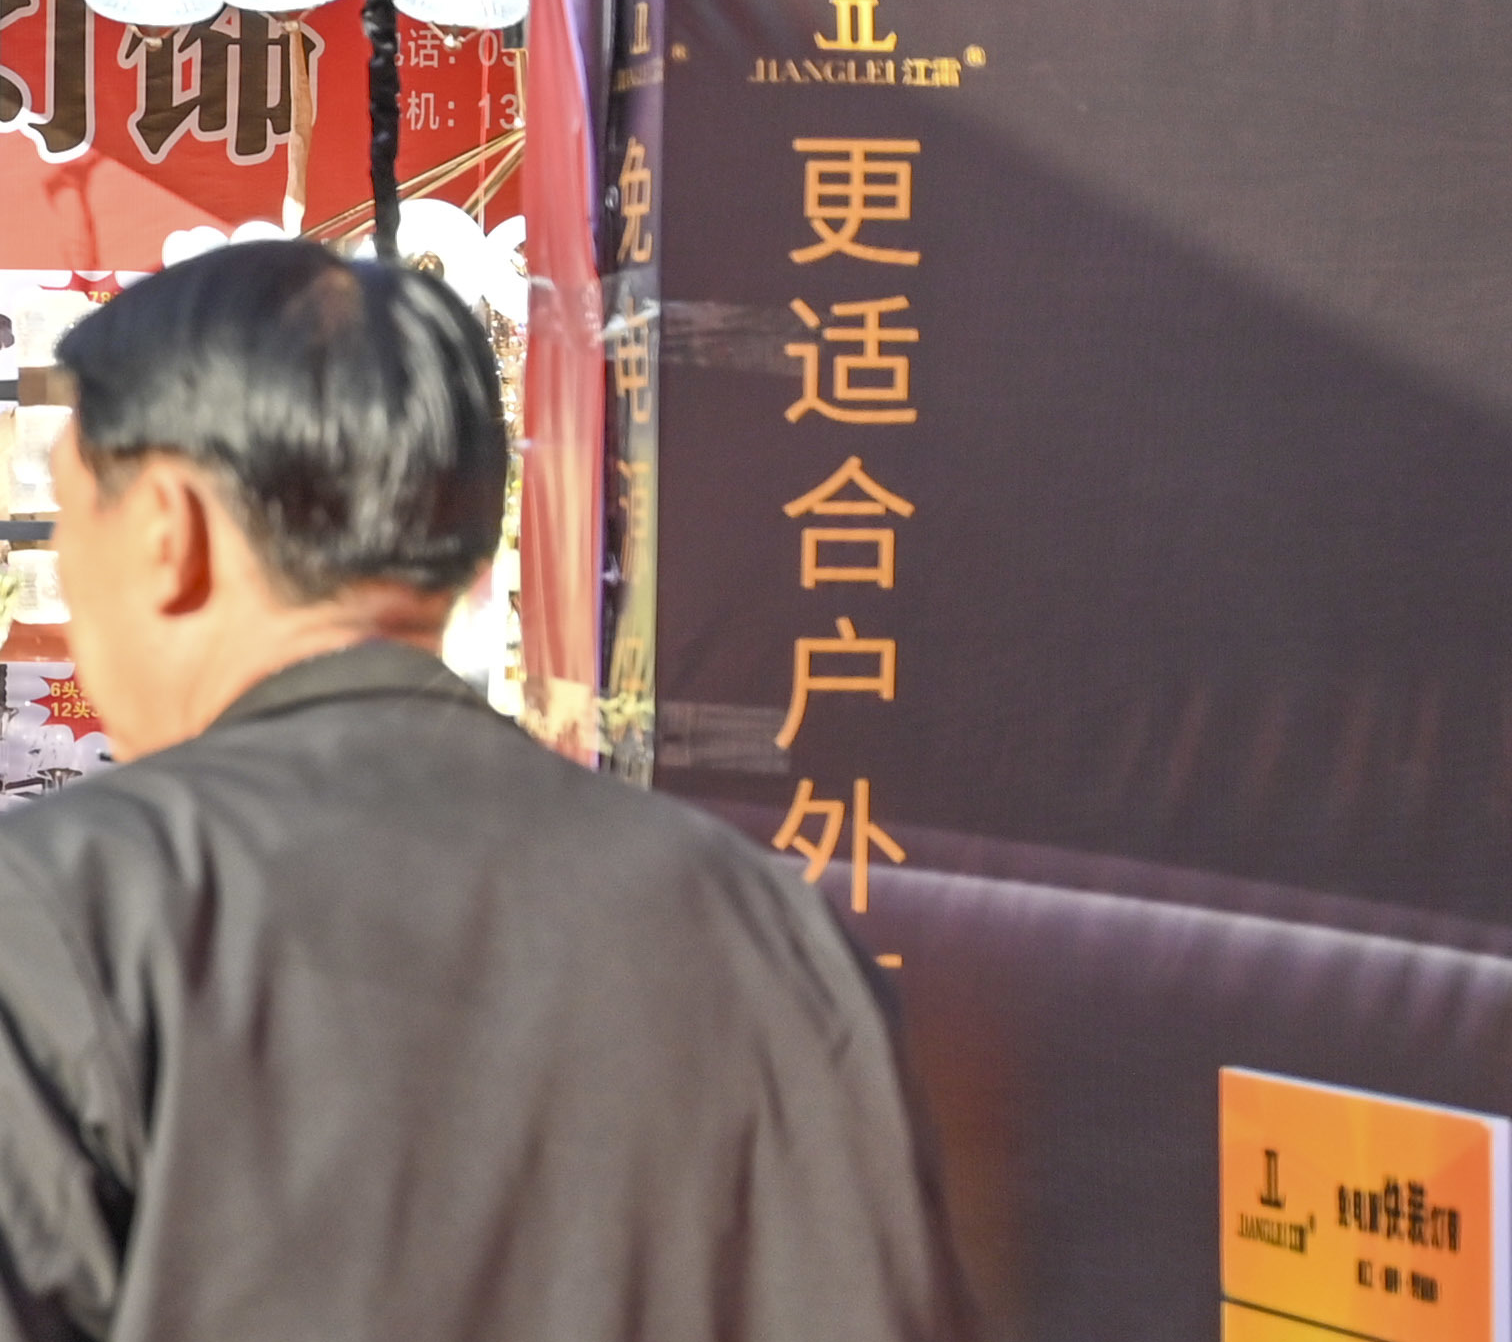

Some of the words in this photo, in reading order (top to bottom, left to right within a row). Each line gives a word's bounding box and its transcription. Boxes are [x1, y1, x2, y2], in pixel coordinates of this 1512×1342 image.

[395, 90, 455, 130] 机：
[772, 137, 921, 967] 更适合户外
